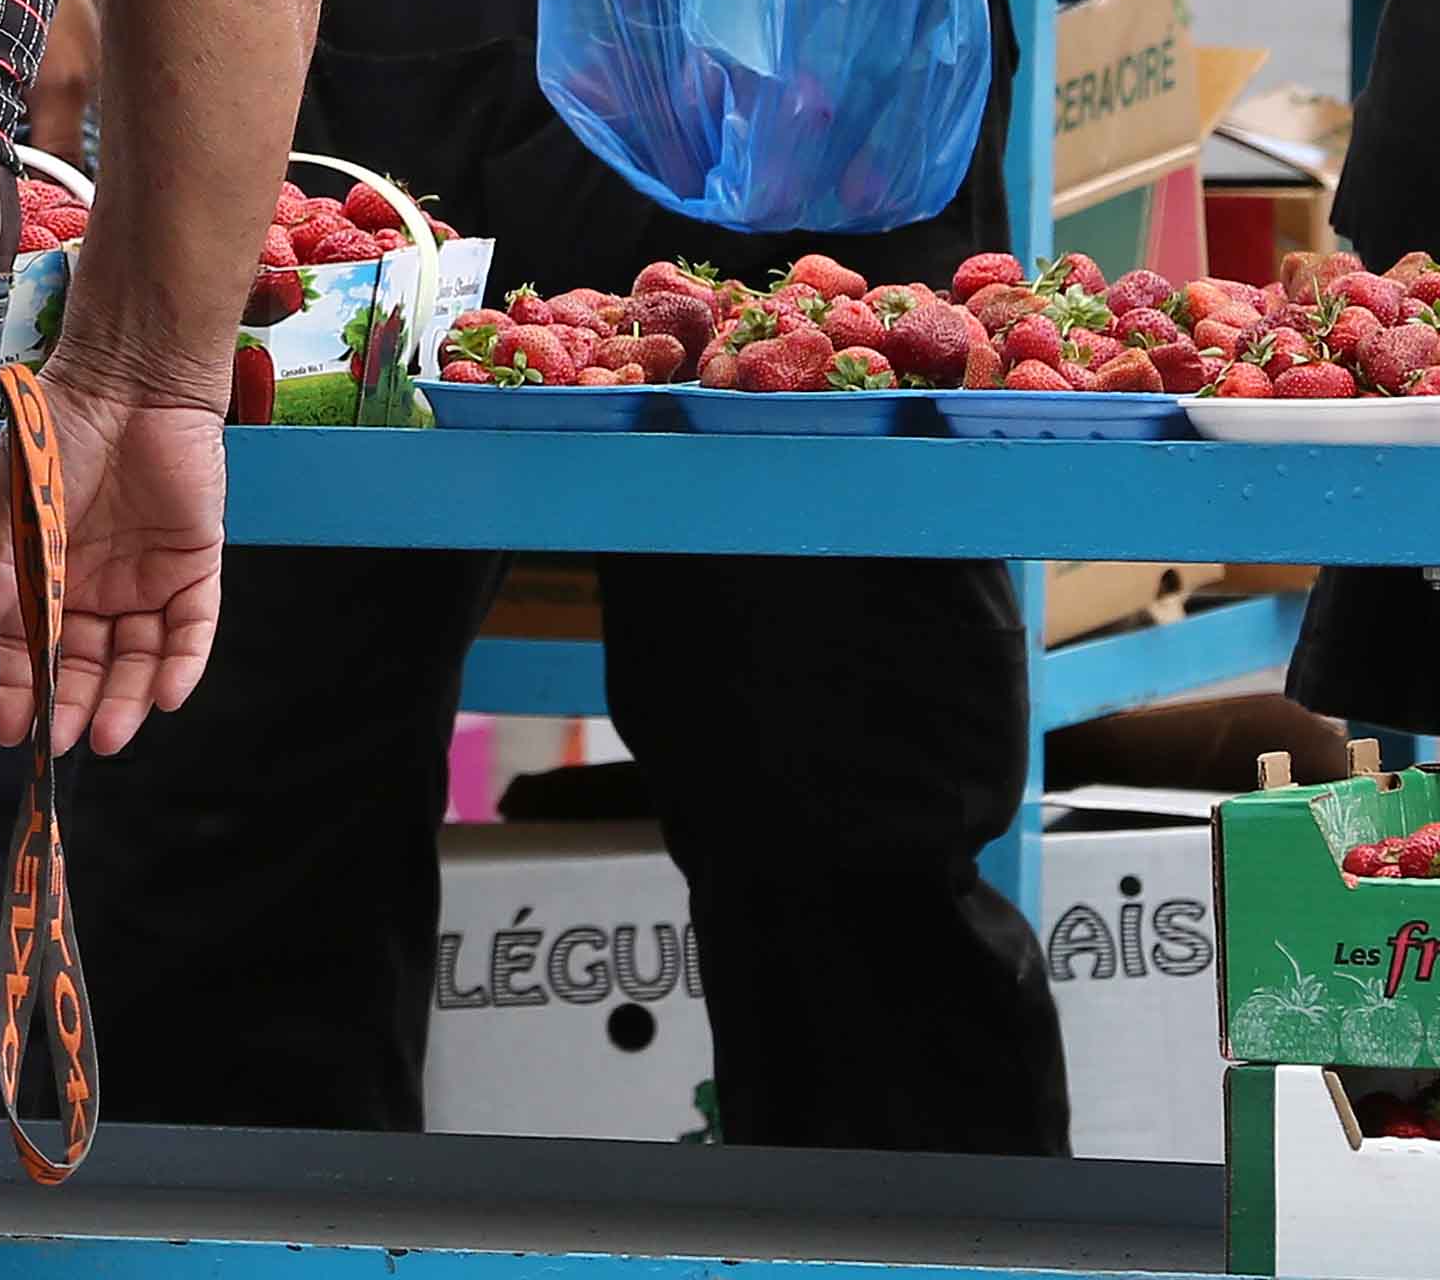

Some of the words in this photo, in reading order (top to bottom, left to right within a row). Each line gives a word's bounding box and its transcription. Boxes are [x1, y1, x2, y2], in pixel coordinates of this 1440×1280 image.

[280, 366, 307, 378] Canada
[436, 906, 704, 1010] LÉGU
[1334, 942, 1381, 968] Les
